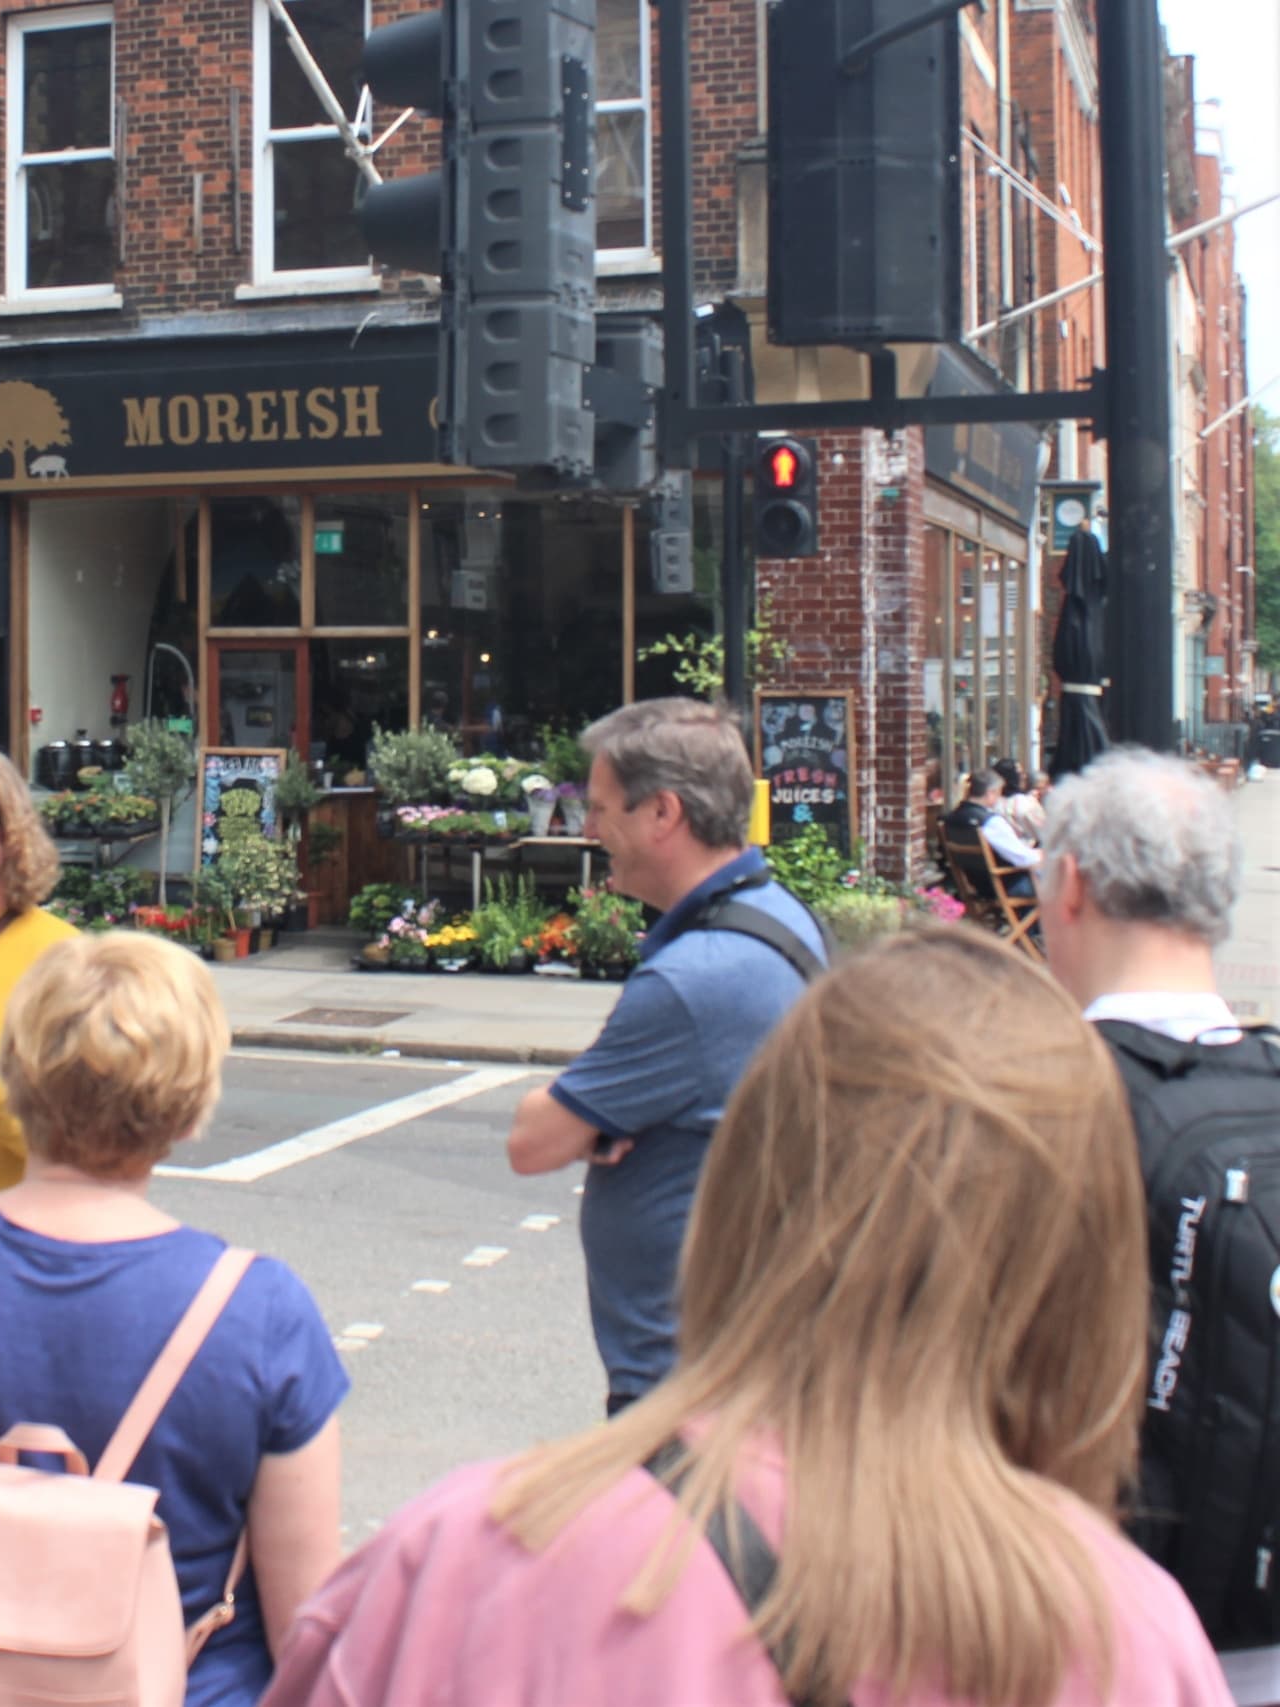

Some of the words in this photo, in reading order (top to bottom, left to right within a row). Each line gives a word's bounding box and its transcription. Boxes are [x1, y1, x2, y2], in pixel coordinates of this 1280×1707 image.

[122, 385, 383, 447] MOREISH
[773, 767, 838, 789] FRESH
[1146, 1309, 1193, 1412] BEACH
